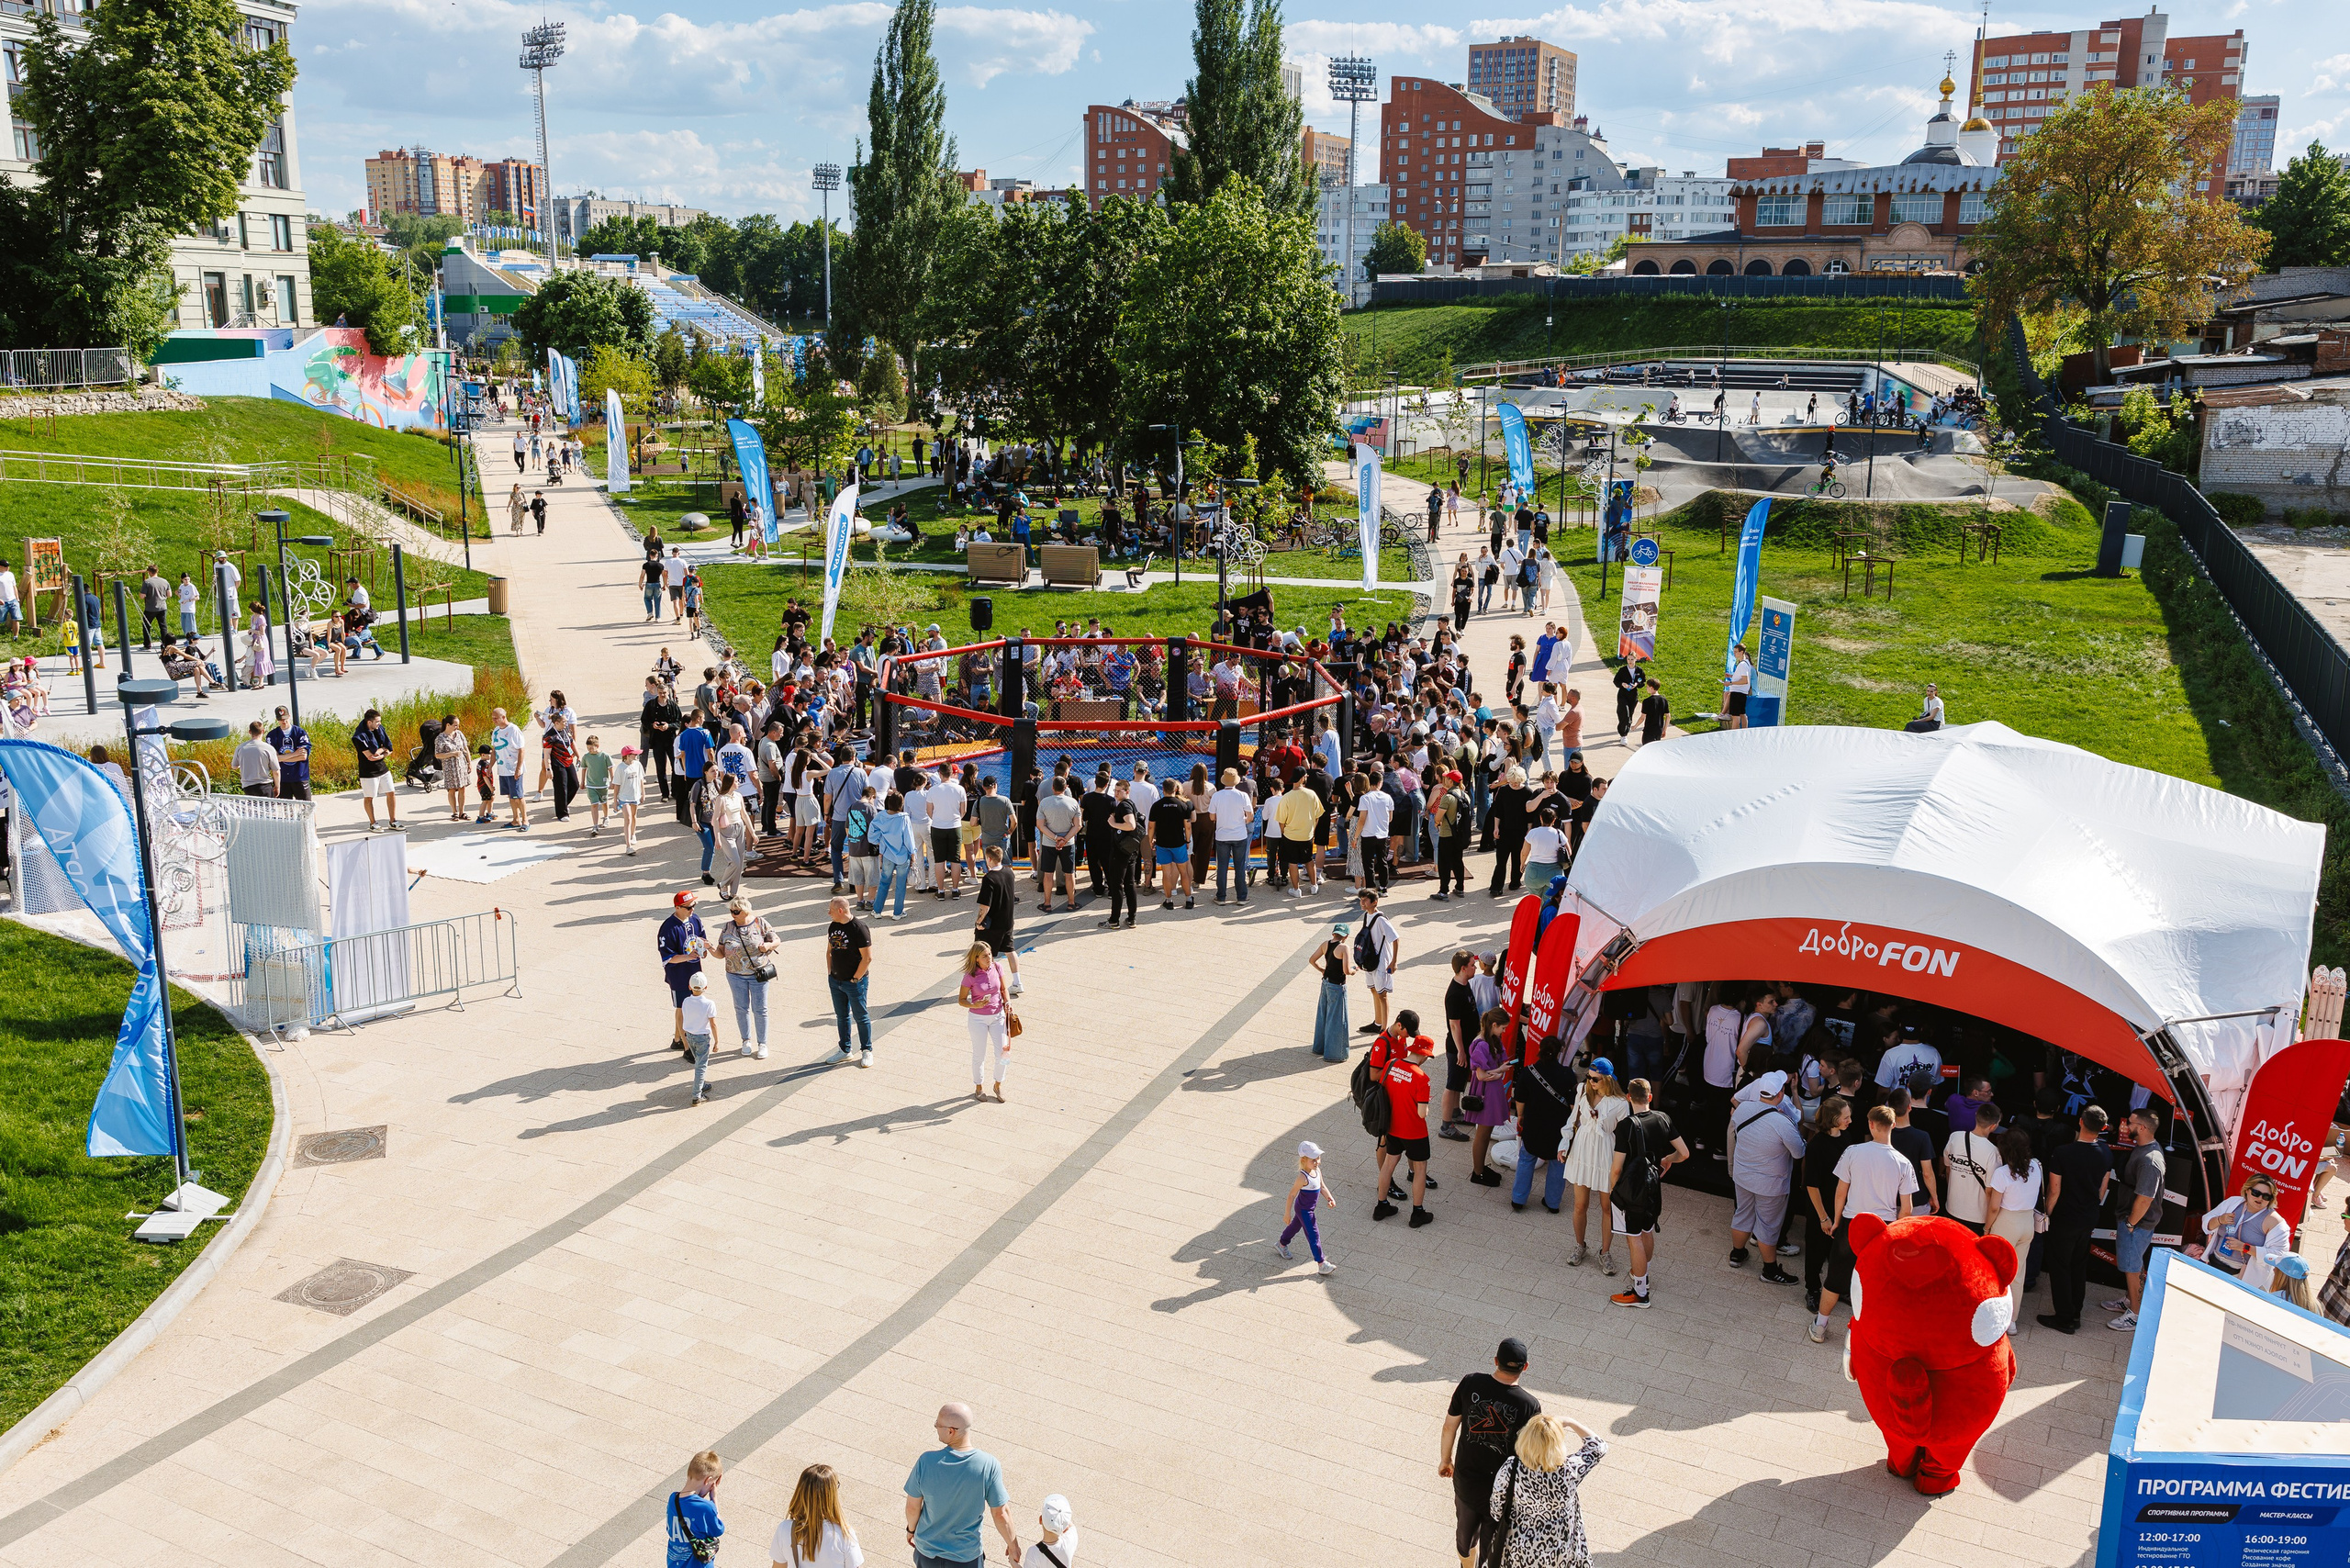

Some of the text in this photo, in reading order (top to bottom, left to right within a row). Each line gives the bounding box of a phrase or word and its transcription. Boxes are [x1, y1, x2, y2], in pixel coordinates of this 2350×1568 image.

[832, 521, 847, 571] КУЛЬТУРА
[1502, 982, 1517, 1008] ON
[2249, 1119, 2313, 1153] Добро
[2244, 1140, 2309, 1180] FON
[2092, 1248, 2115, 1262] Добрее
[2137, 1478, 2266, 1497] ПРОГРАММА
[2139, 1532, 2201, 1542] 12:00-17:00
[2244, 1535, 2308, 1545] 16:00-19:00
[2138, 1545, 2189, 1553] Индивидуальное
